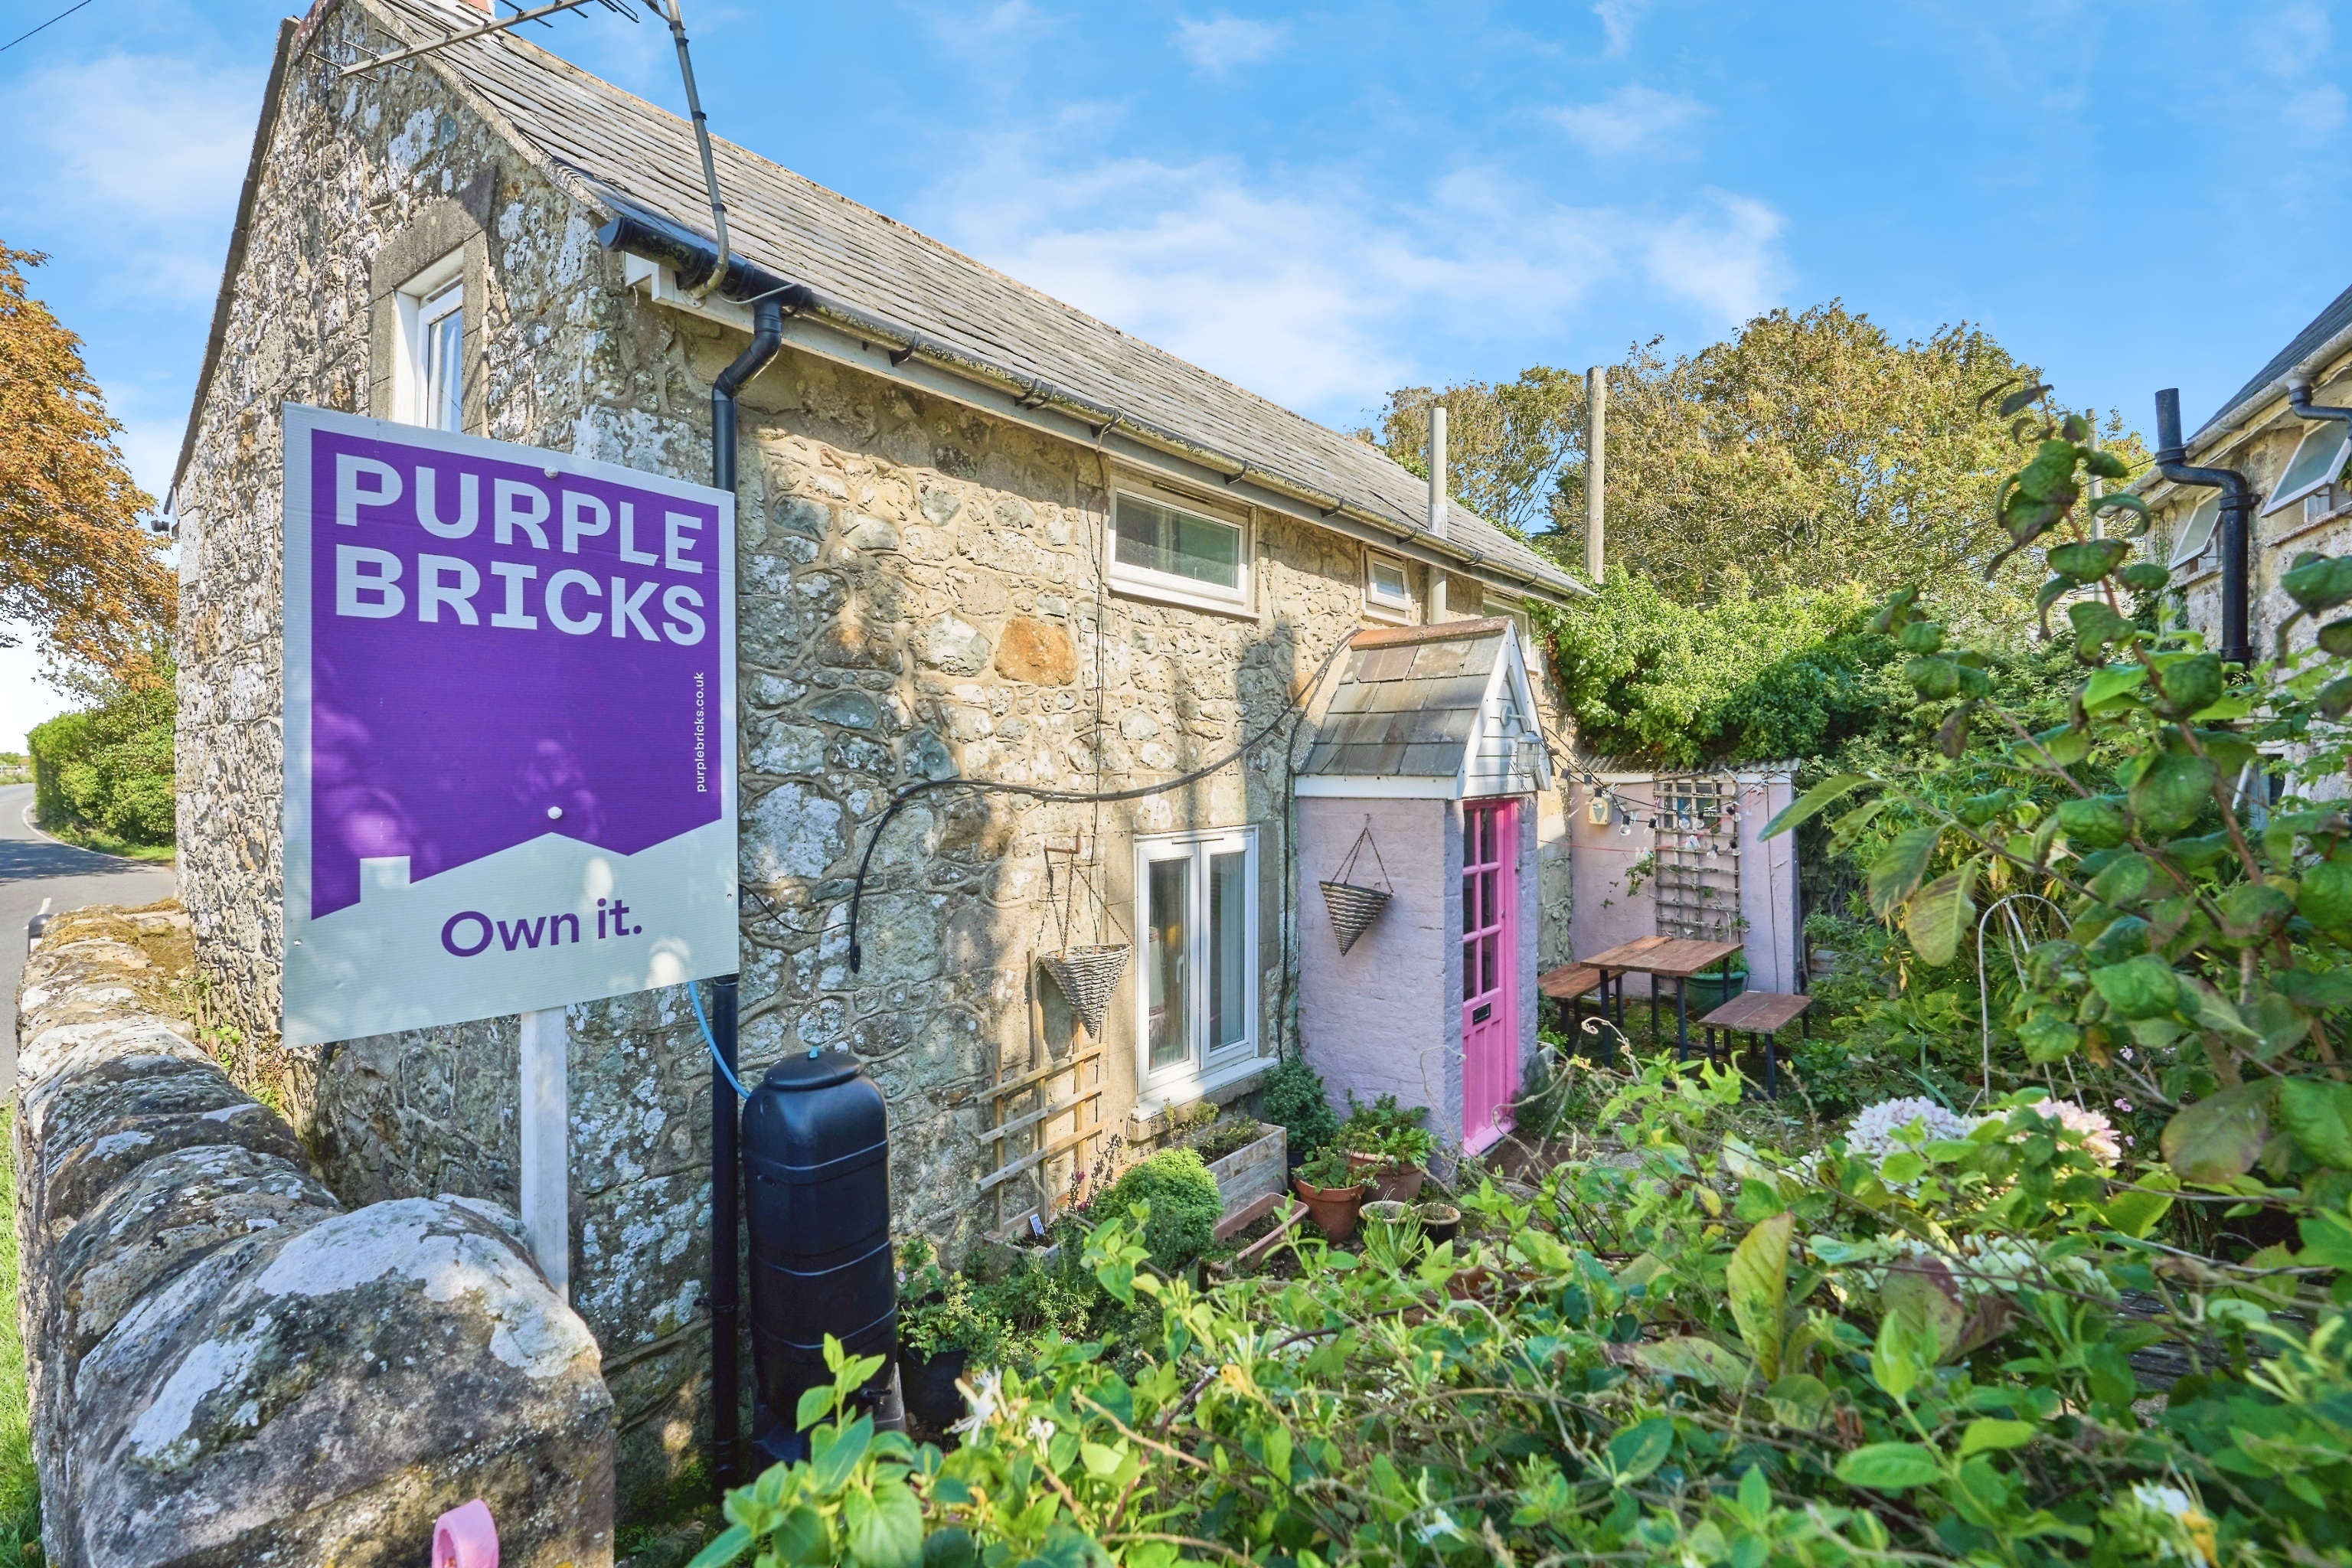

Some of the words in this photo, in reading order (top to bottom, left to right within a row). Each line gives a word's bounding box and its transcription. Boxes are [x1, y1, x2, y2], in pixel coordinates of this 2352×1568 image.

[335, 452, 703, 574] PURPLE
[336, 544, 706, 646] BRICKS
[694, 672, 707, 792] purplebricks.co.uk
[440, 910, 580, 958] Own
[596, 897, 642, 939] it.
